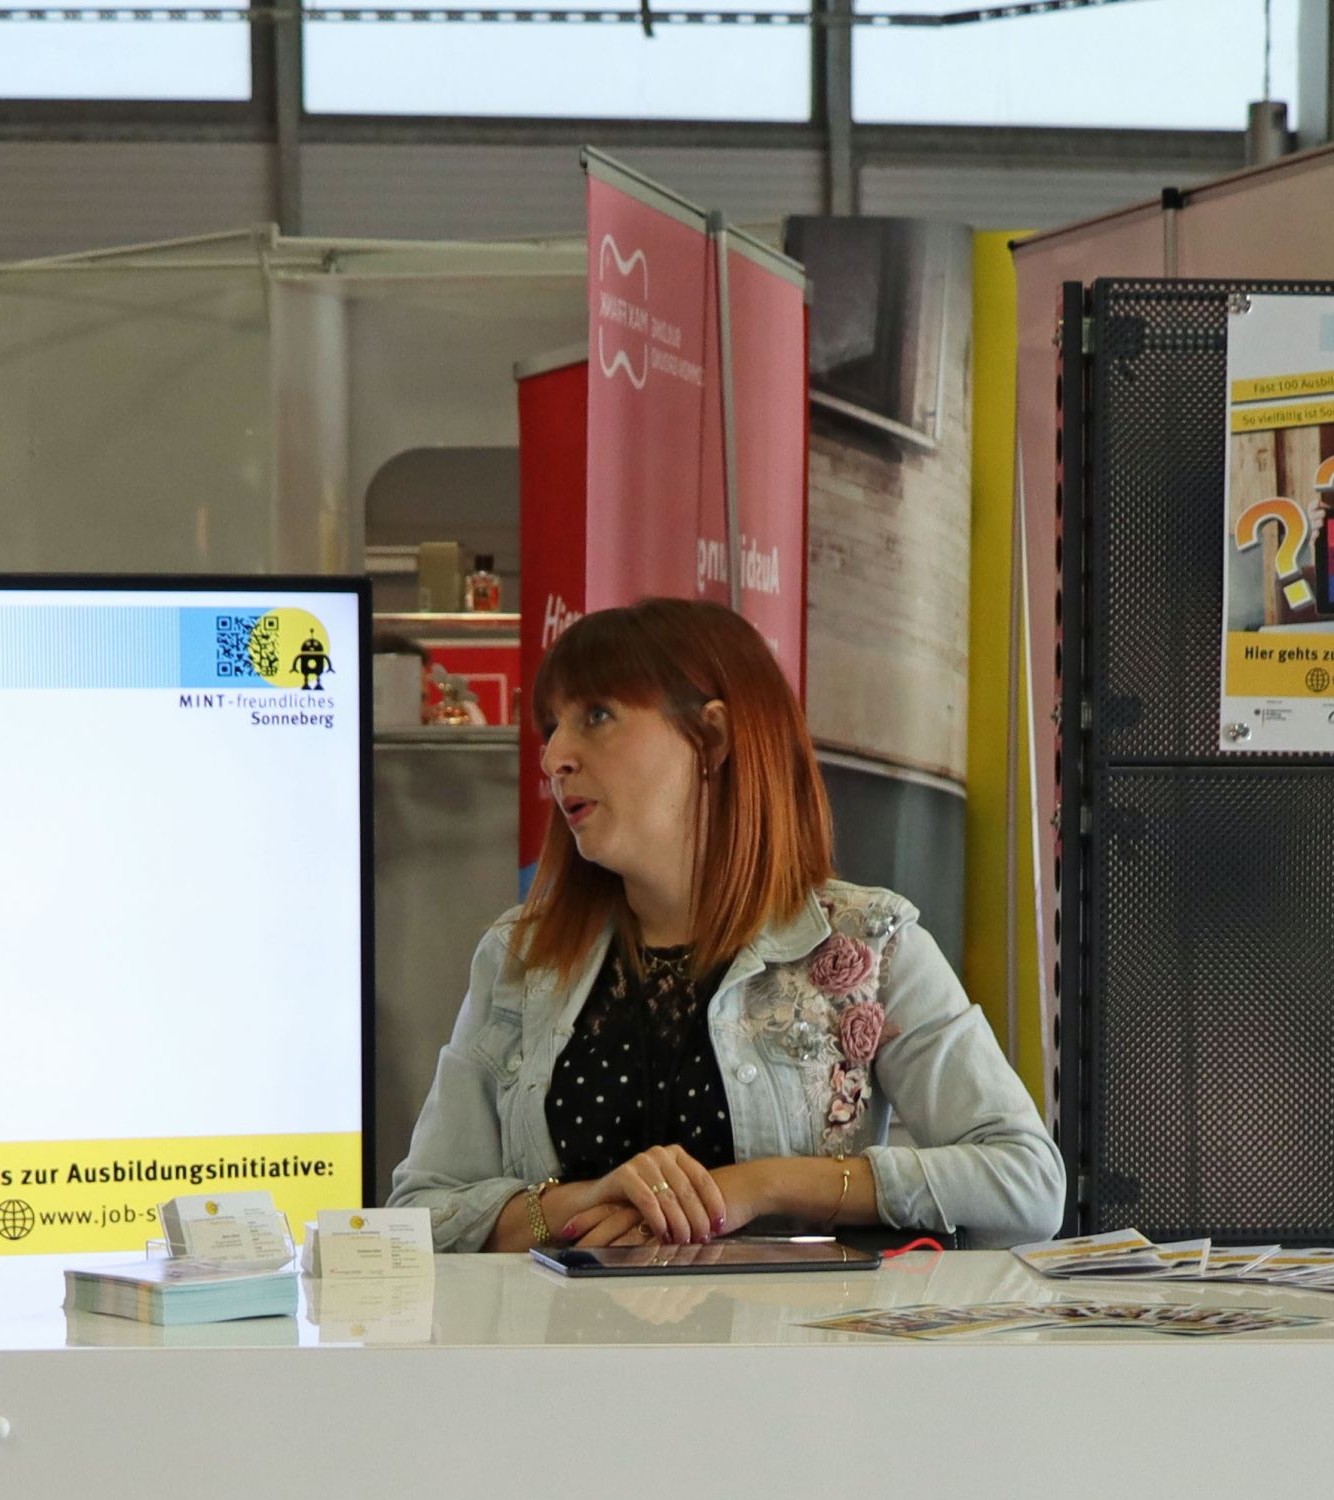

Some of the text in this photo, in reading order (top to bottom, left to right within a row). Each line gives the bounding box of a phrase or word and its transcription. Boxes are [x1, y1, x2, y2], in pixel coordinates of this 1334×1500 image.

[1254, 380, 1276, 394] Fast
[1279, 378, 1298, 391] 100
[1243, 414, 1256, 426] So
[1245, 646, 1273, 661] Hier
[1279, 646, 1318, 663] gehts
[179, 693, 335, 709] MINT-freundliches
[252, 711, 334, 729] Sonneberg
[21, 1167, 58, 1185] zur
[67, 1155, 335, 1184] Ausbildungsinitiative:
